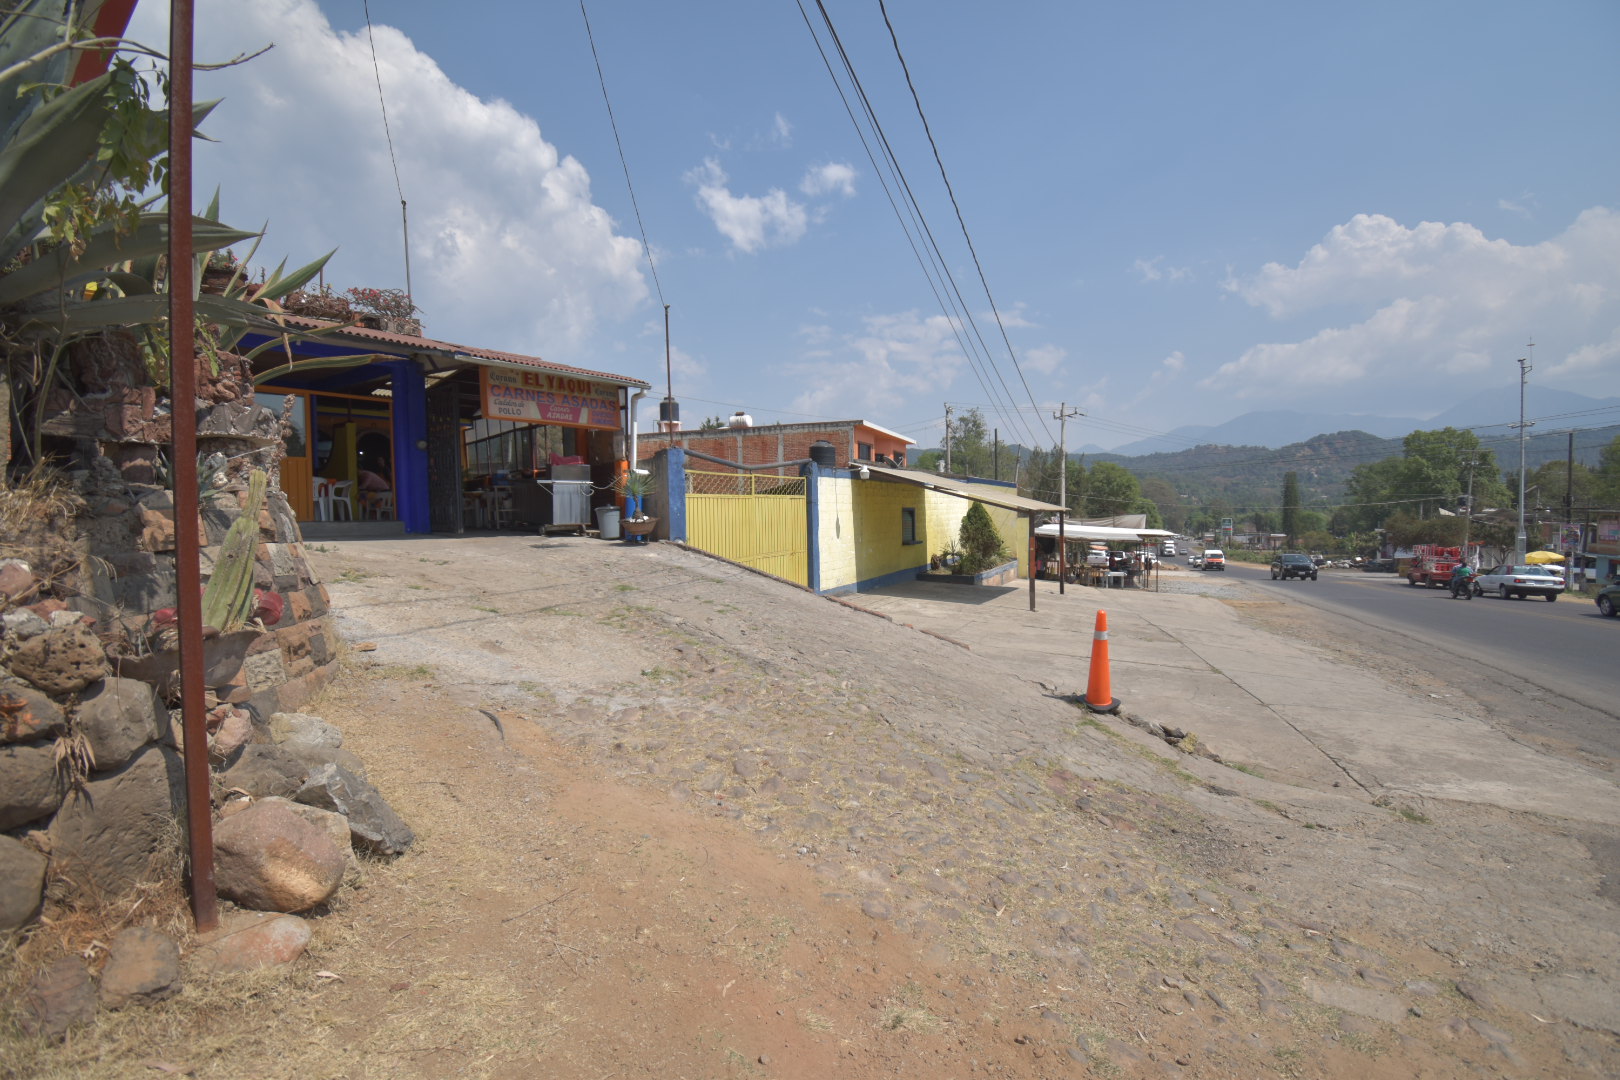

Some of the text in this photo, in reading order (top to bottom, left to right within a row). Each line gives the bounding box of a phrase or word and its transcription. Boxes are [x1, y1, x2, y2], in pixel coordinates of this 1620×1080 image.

[523, 371, 592, 394] EL YAQUI
[491, 384, 617, 412] CARNES ASADAS
[498, 407, 522, 416] POLLO
